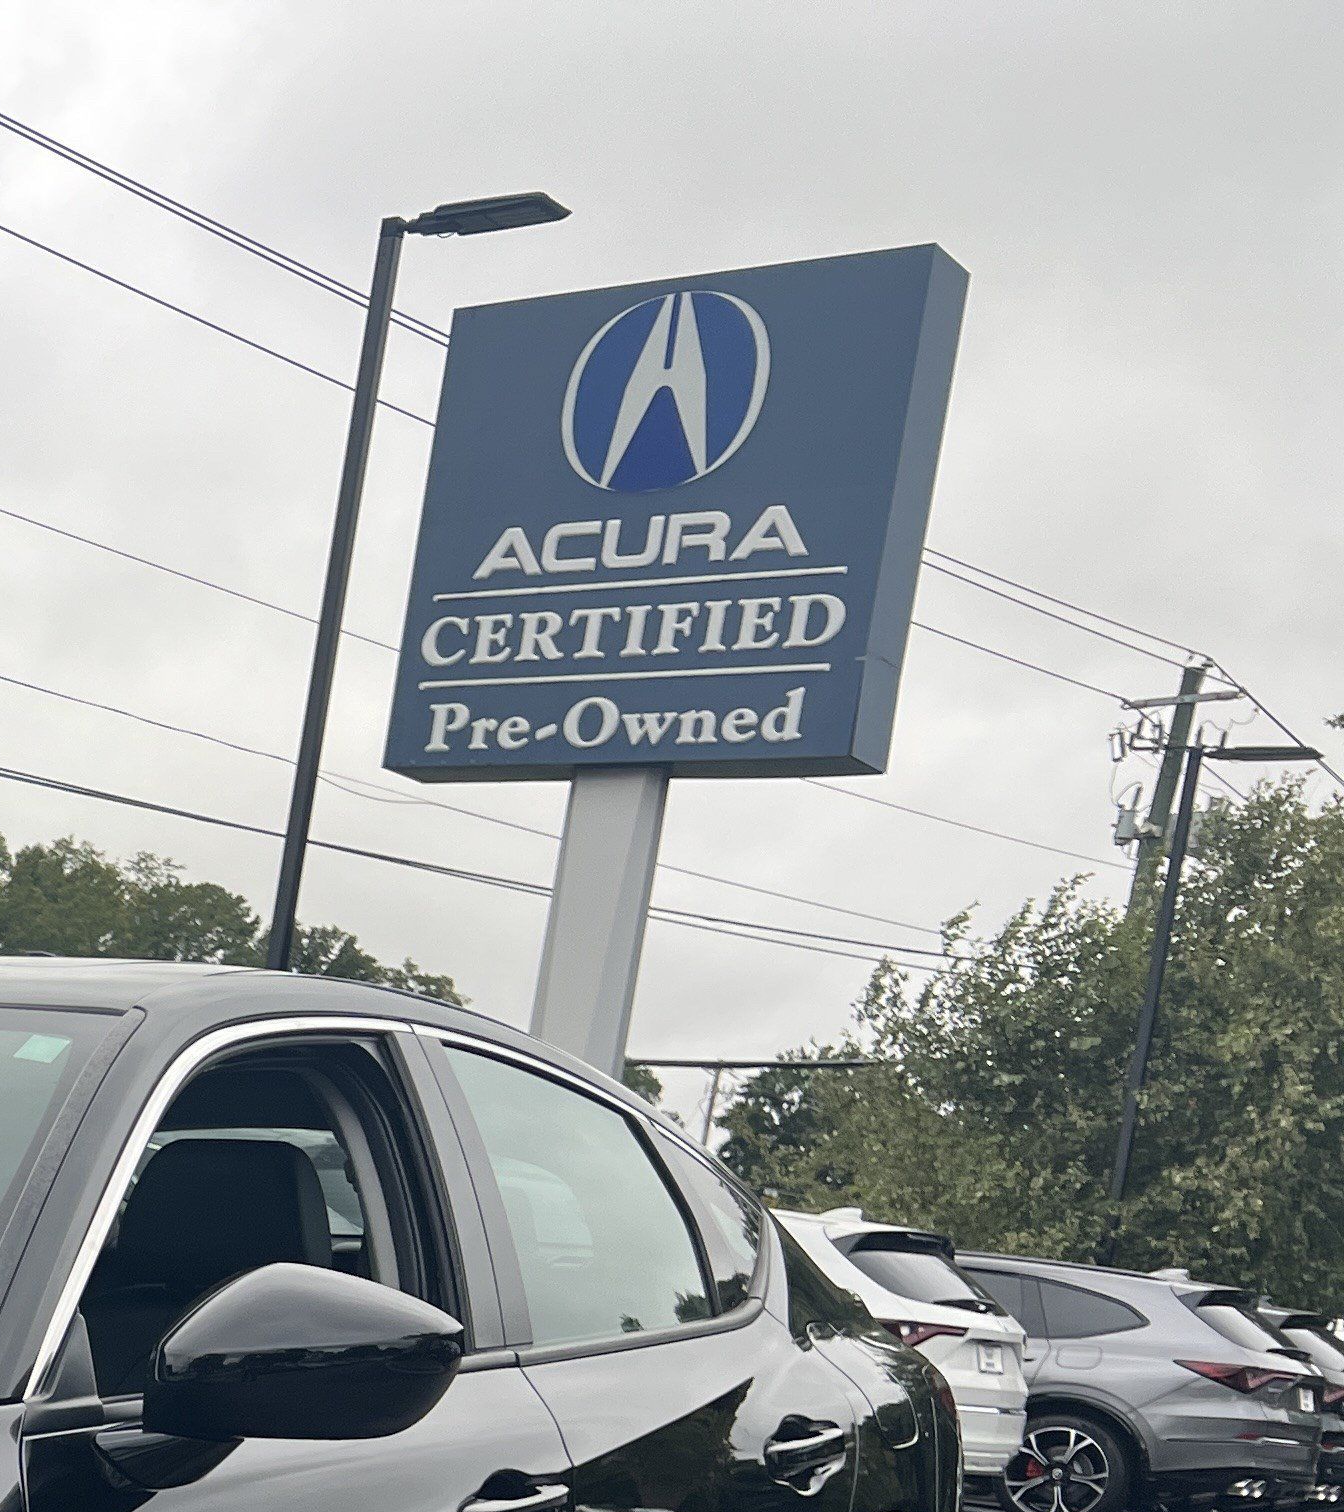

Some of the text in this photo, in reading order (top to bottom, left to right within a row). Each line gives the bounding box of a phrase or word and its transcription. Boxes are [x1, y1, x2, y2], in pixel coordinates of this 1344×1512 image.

[472, 503, 810, 580] ACURA
[420, 593, 848, 667] CERTIFIED
[424, 686, 807, 752] Pre-Owned
